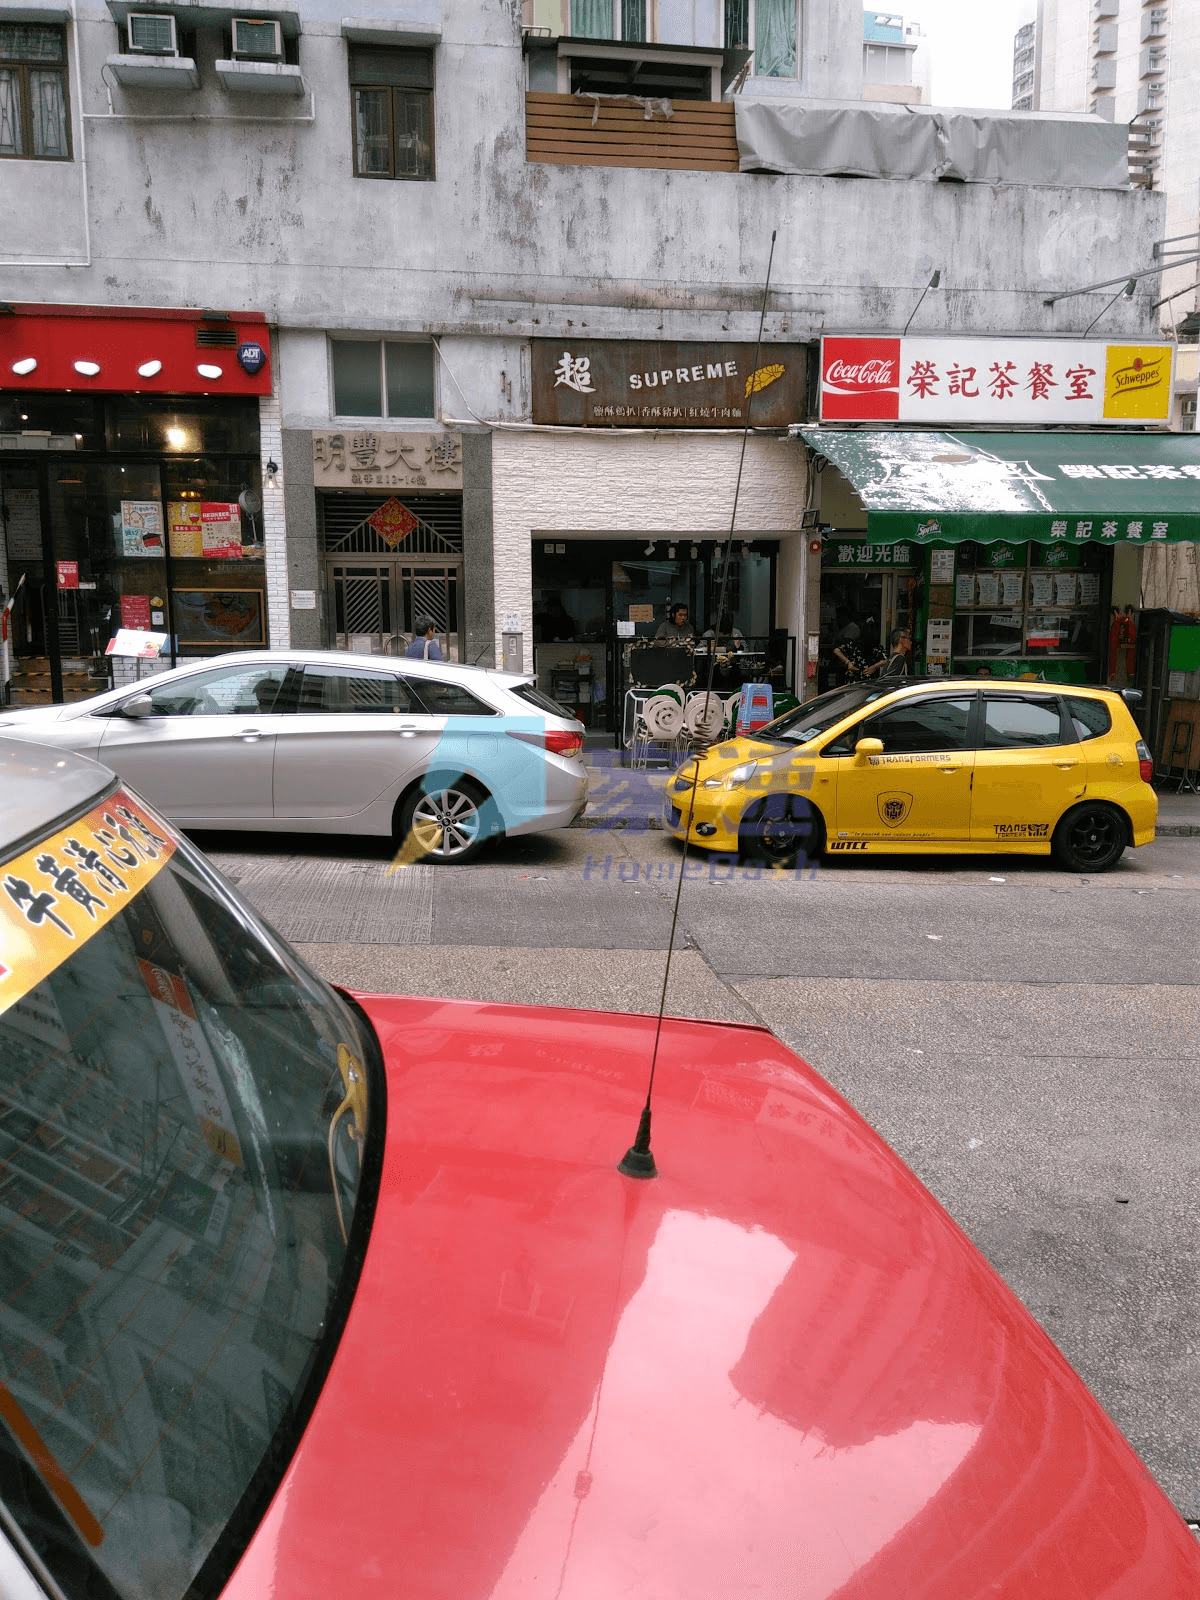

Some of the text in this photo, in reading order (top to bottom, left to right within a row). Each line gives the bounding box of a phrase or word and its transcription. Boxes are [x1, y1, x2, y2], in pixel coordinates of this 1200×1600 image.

[242, 349, 260, 358] ADT
[553, 351, 597, 393] 超
[629, 360, 739, 390] SUPREME
[826, 358, 896, 384] Coca-Cola
[906, 359, 1097, 401] 榮記茶餐室
[1115, 367, 1161, 389] Schweppes
[314, 432, 462, 473] 明豐大樓
[917, 523, 941, 537] Sprite
[1050, 520, 1169, 539] 榮記茶餐室
[838, 544, 910, 563] 歡迎光臨
[991, 550, 1014, 564] Sprite
[1045, 550, 1068, 564] Sprite
[880, 754, 952, 764] TRANSFORMERS
[993, 824, 1028, 834] TRANS
[830, 841, 871, 850] WTCC
